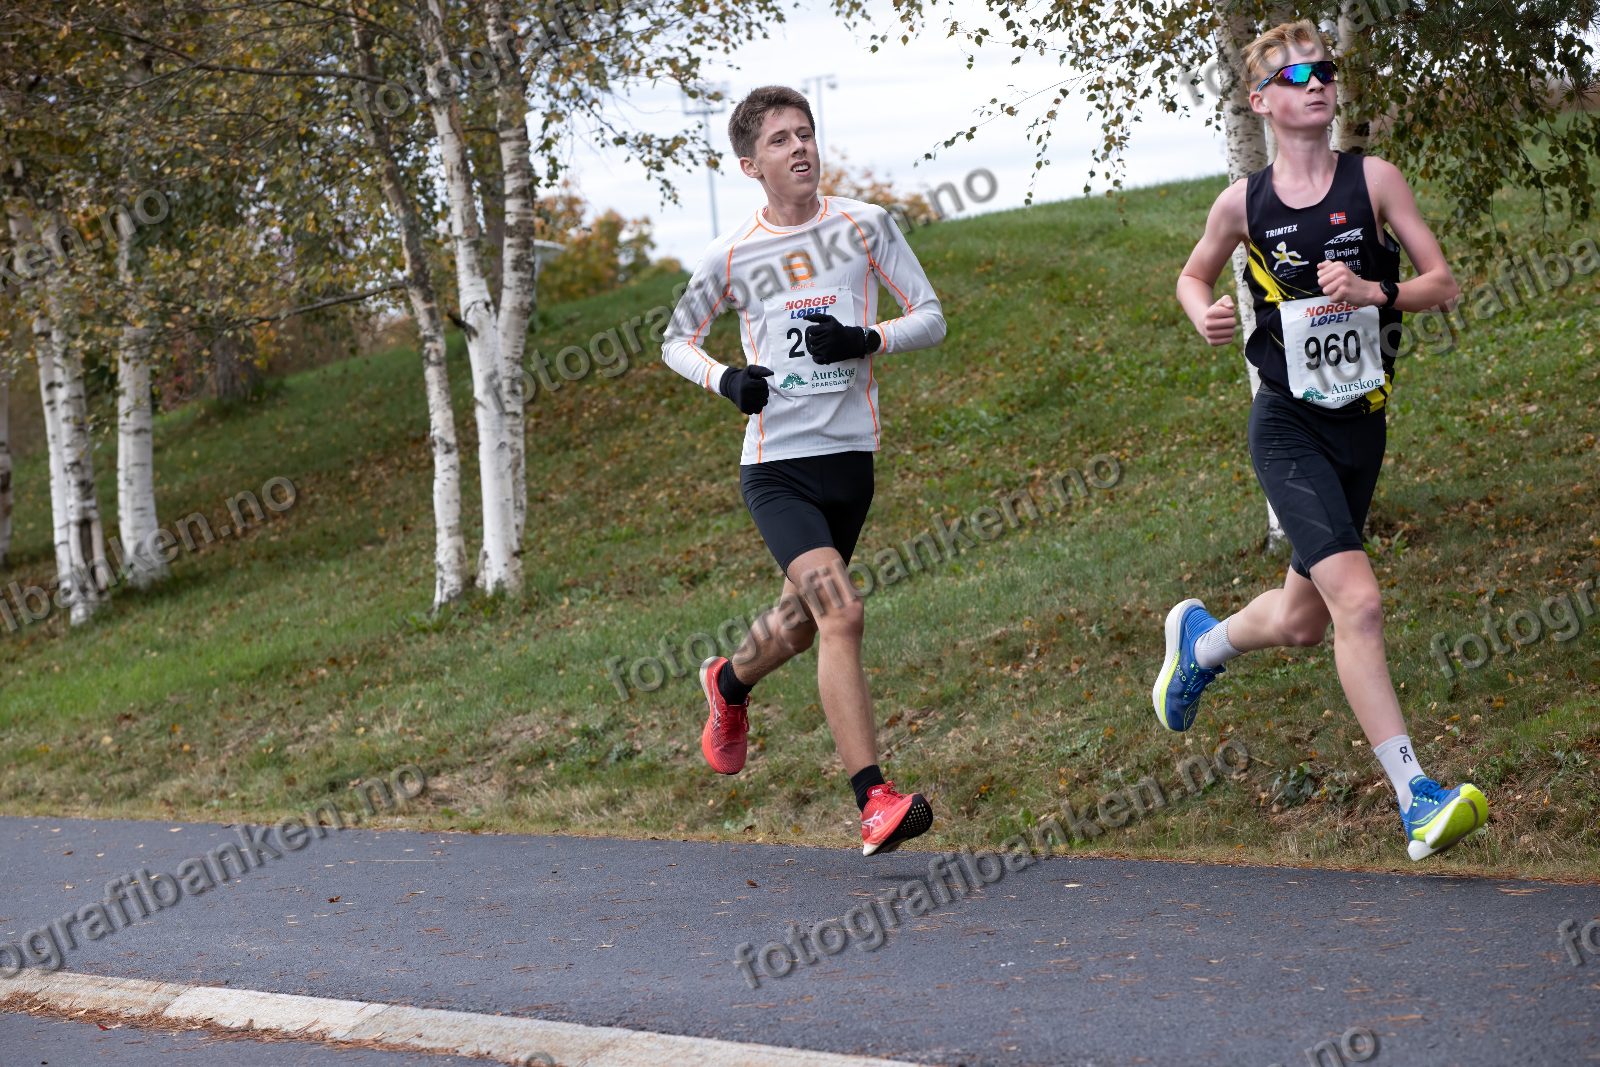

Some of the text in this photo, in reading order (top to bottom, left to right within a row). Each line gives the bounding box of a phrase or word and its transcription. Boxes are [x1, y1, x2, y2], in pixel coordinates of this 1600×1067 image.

[1265, 224, 1298, 239] TRIMTEX
[786, 295, 837, 311] NORGES
[1310, 312, 1353, 328] LØPET
[1304, 329, 1361, 371] 960
[811, 367, 856, 381] Aurskog
[1331, 378, 1381, 395] Aurskog
